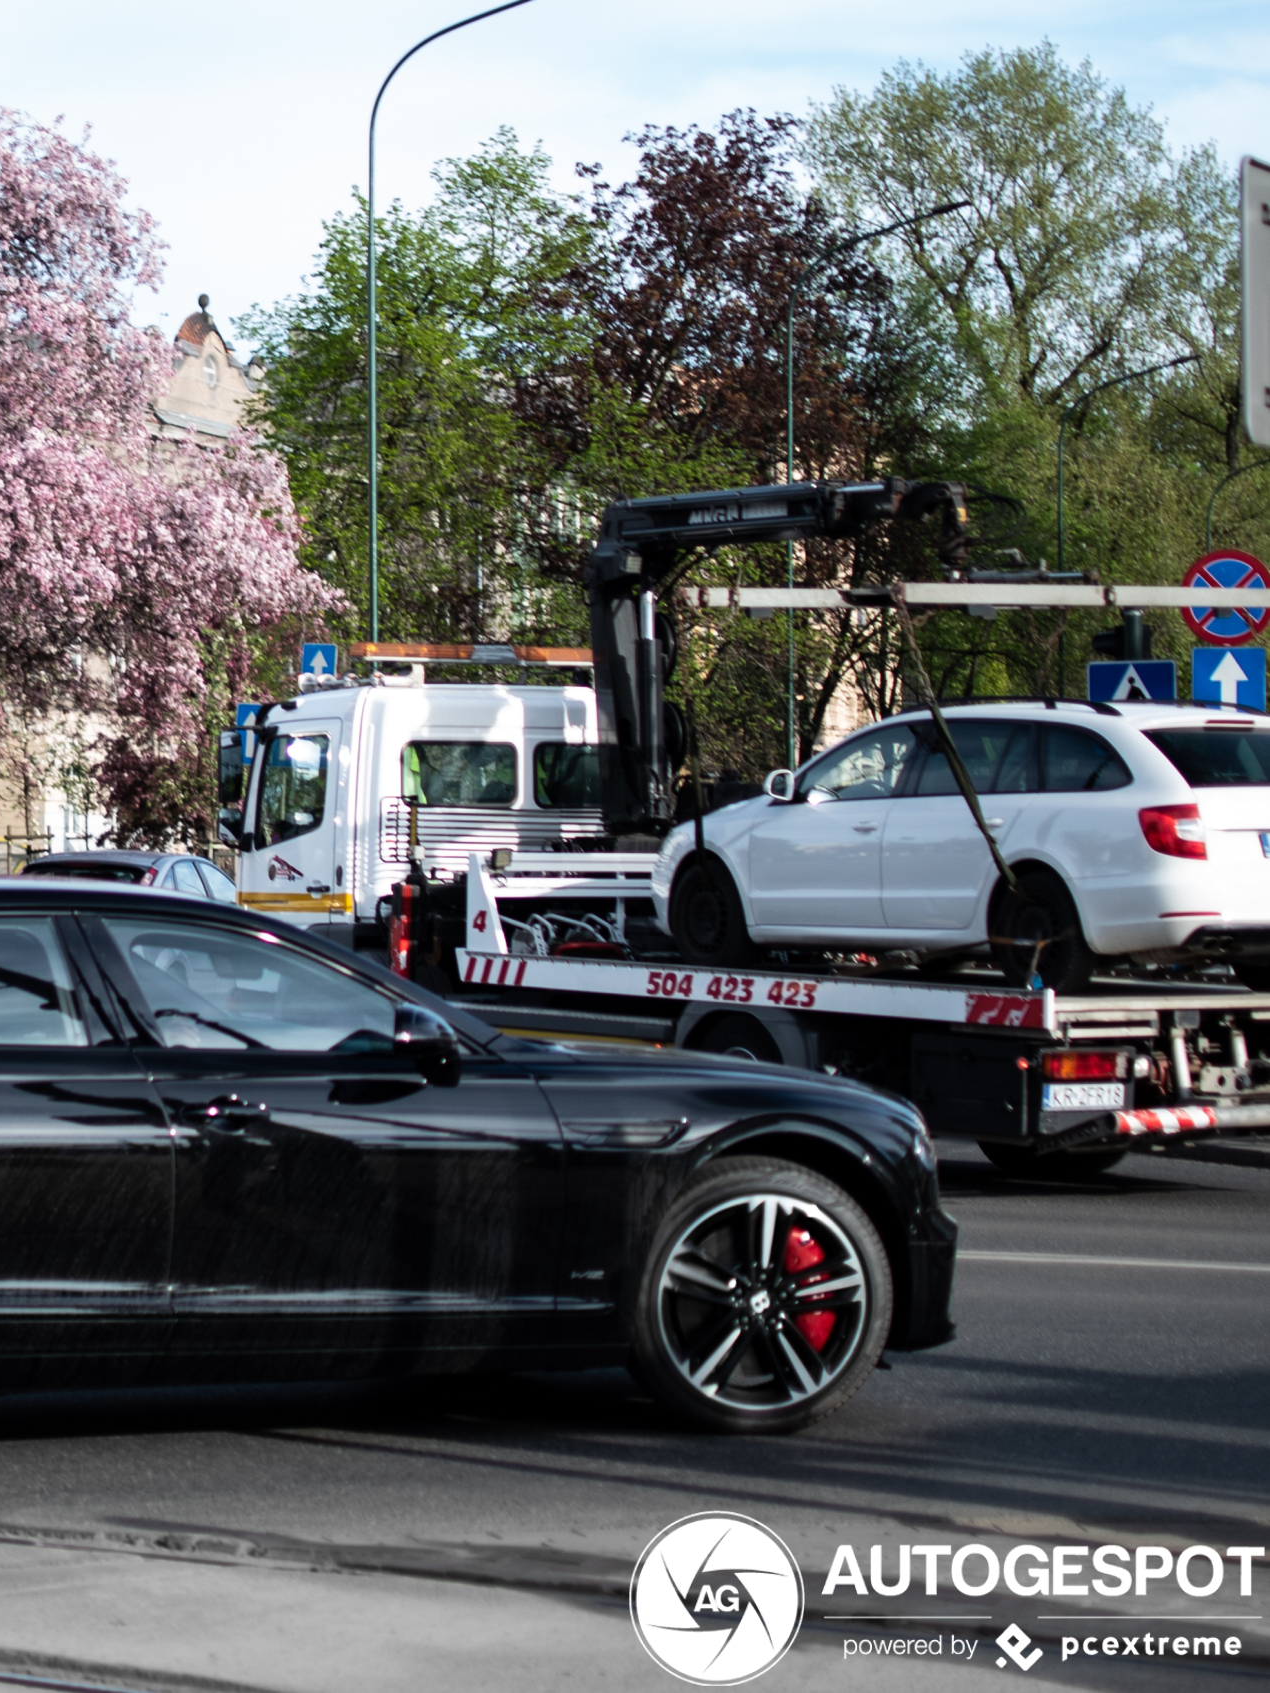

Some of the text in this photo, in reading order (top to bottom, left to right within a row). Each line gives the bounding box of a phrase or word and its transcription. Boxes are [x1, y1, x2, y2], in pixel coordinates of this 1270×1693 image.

[473, 909, 487, 933] 4
[646, 971, 818, 1008] 504 423 423
